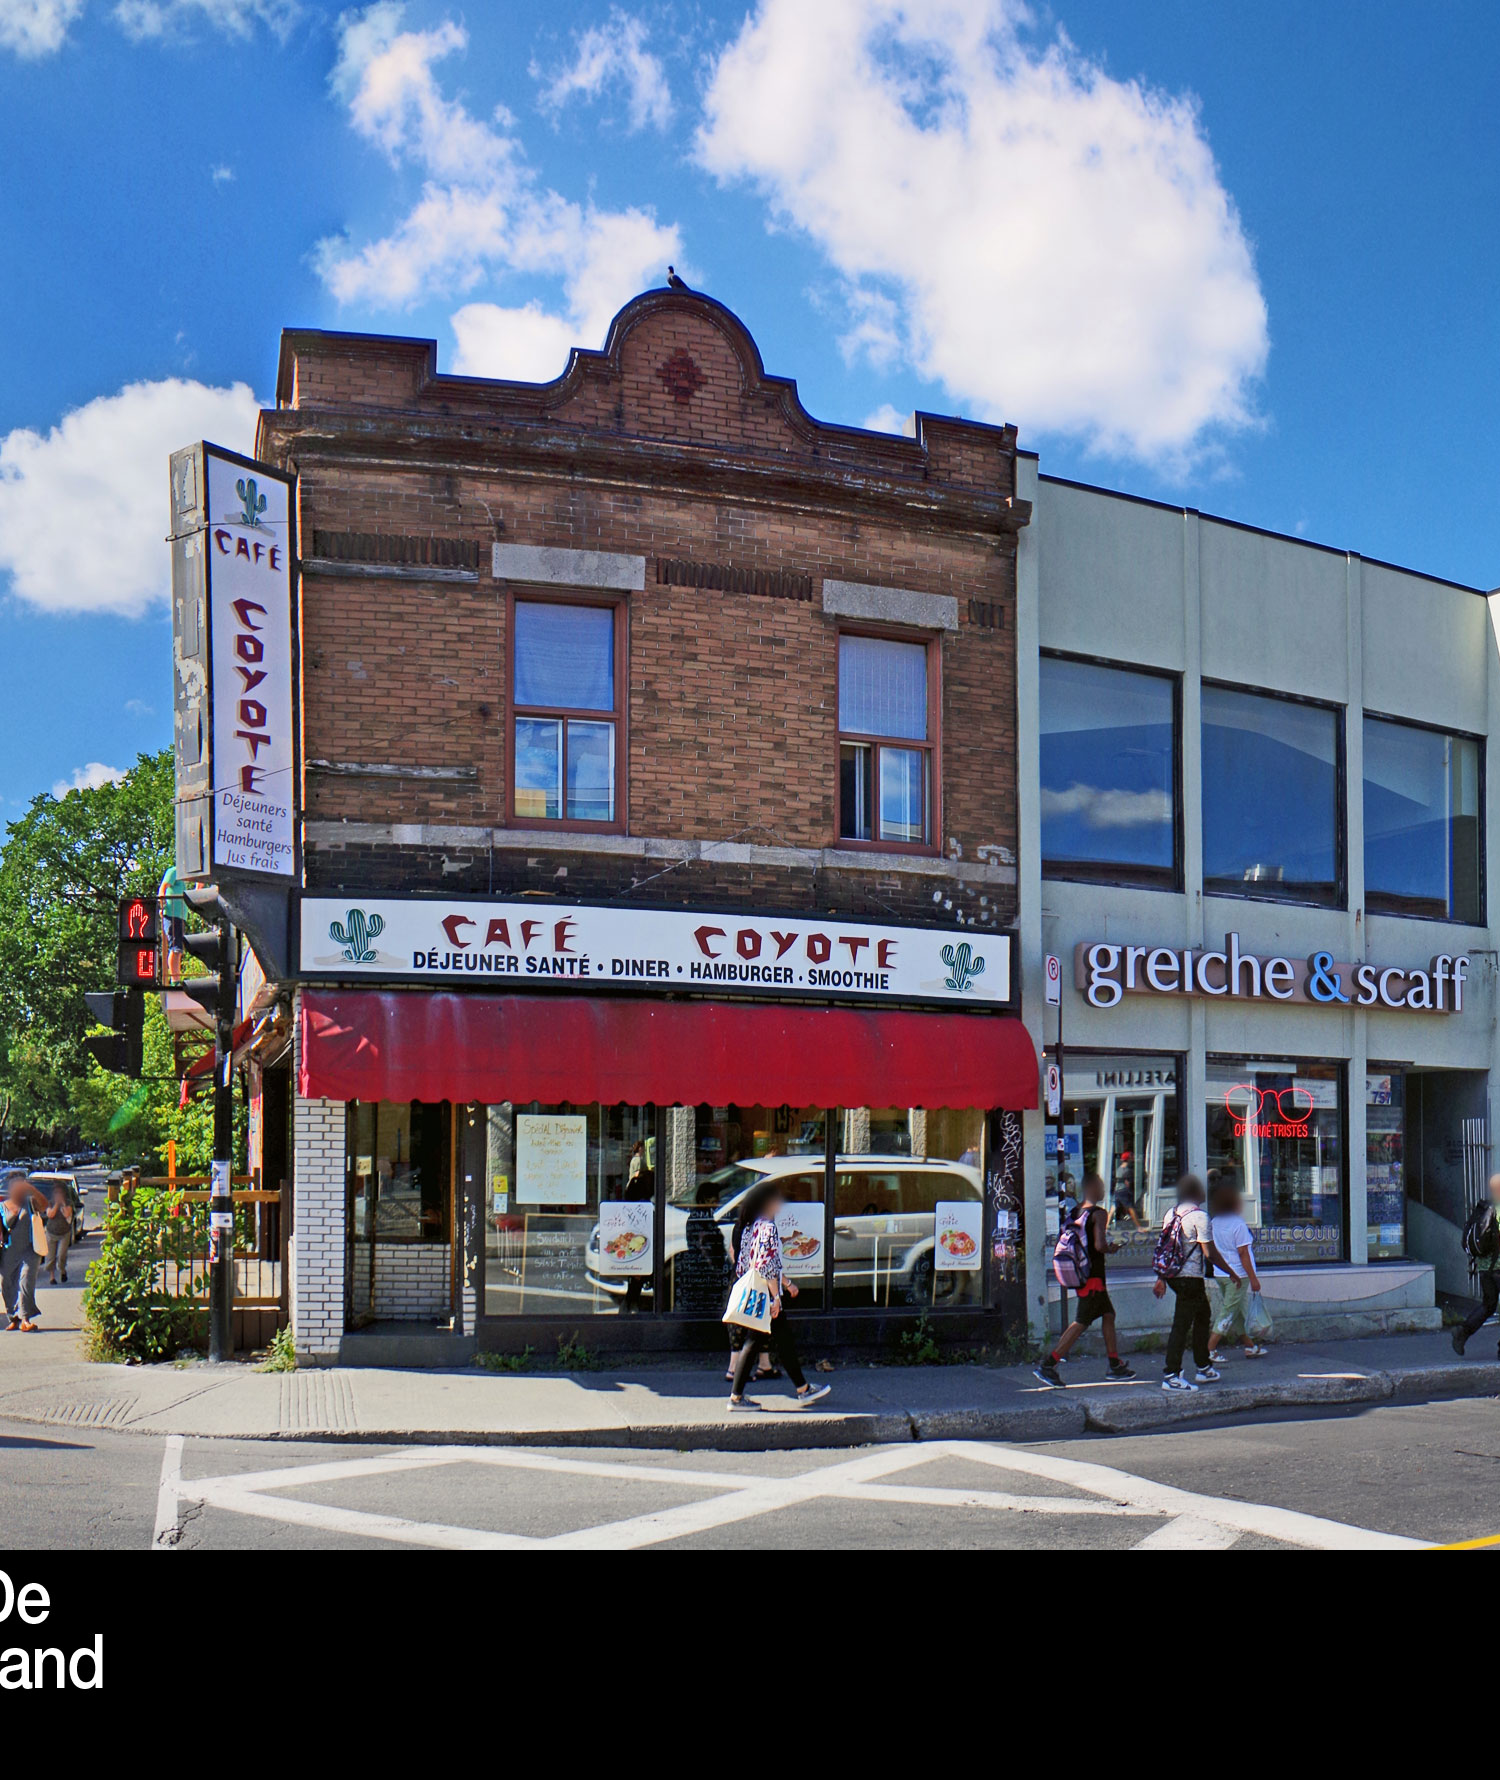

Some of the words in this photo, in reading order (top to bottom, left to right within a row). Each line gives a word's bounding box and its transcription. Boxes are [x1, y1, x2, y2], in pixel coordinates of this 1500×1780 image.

[215, 529, 281, 571] CAFÉ
[233, 598, 271, 795] COYOTE
[223, 793, 286, 818] Déjeuners
[237, 817, 272, 832] santé
[217, 829, 292, 855] Hamburgers
[224, 849, 246, 866] Jus
[250, 852, 279, 870] frais
[441, 914, 579, 953] CAFÉ
[694, 925, 899, 970] COYOTE
[413, 947, 518, 973] DÉJEUNER
[526, 953, 590, 976] SANTÉ
[611, 959, 670, 978] DINER
[690, 962, 793, 985] HAMBURGER
[808, 969, 889, 990] SMOOTHIE
[1086, 932, 1295, 1008] greiche
[1308, 950, 1350, 1003] &
[1357, 954, 1471, 1011] scaff
[1234, 1121, 1309, 1138] OPTOMÉTRISTES
